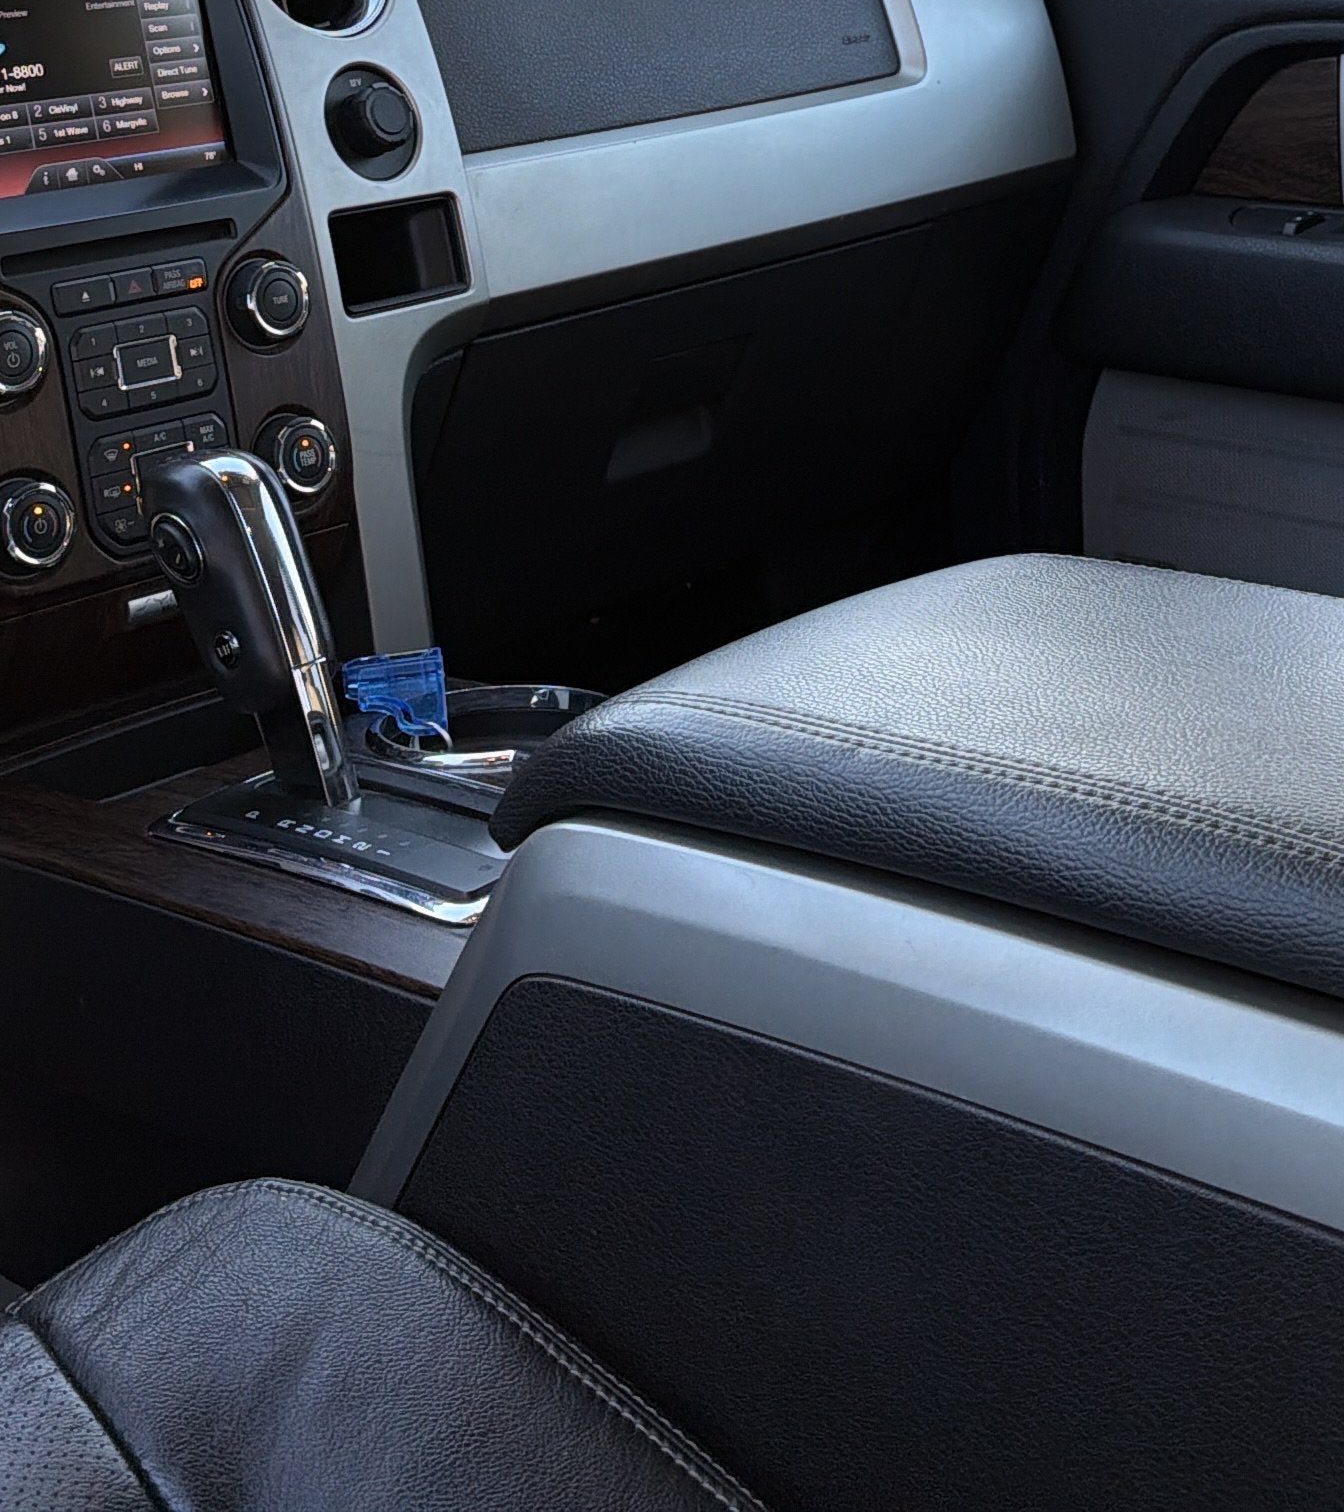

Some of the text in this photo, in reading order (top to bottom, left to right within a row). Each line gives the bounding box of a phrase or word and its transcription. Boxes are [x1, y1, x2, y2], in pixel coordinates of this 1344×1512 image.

[143, 0, 169, 12] Replay
[148, 23, 168, 33] Scan
[152, 44, 182, 56] Options
[113, 60, 140, 72] ALERT
[157, 65, 198, 78] Direct Tune
[5, 83, 27, 94] Now!
[161, 89, 190, 100] Browse
[98, 95, 144, 109] 3 Highway
[0, 113, 13, 121] on
[34, 105, 42, 118] 2
[102, 120, 111, 133] 6
[38, 129, 47, 141] 5
[66, 126, 89, 137] Wave
[164, 269, 181, 279] PASS
[189, 277, 204, 289] OFF
[272, 294, 289, 305] TUNE
[186, 318, 193, 327] 3
[3, 341, 18, 351] VOL
[136, 356, 158, 368] MEDIA
[101, 378, 204, 407] 4 5 6
[199, 425, 214, 434] MAX
[154, 432, 167, 442] A/C
[203, 433, 215, 443] A/C
[299, 448, 315, 459] PASS
[300, 456, 317, 467] TEMP
[245, 810, 260, 820] P
[277, 819, 297, 829] R
[295, 824, 314, 834] N
[313, 829, 333, 839] D
[331, 834, 352, 845] M
[352, 841, 372, 851] 2
